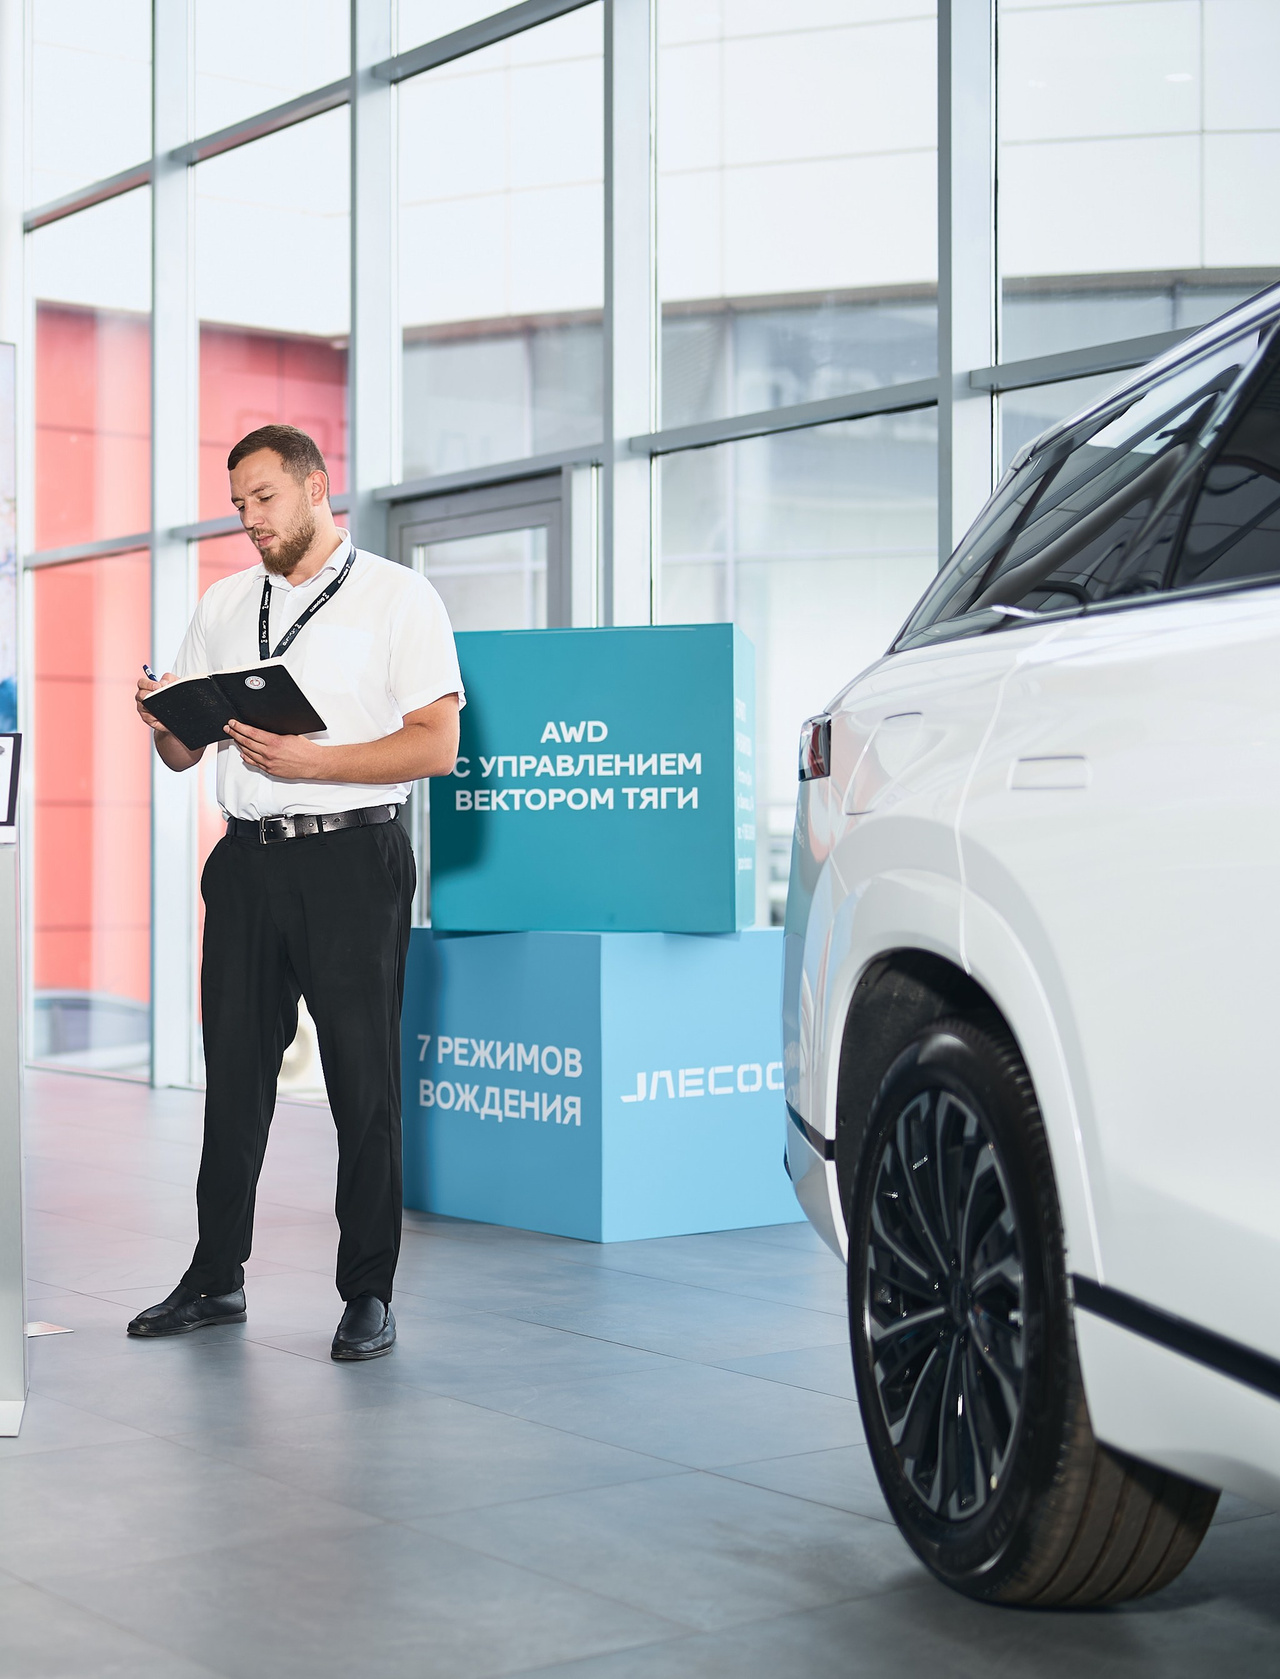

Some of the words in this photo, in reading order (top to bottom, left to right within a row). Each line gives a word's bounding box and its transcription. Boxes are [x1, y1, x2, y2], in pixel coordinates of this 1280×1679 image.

[540, 720, 609, 744] AWD
[452, 756, 471, 778] С
[479, 752, 702, 778] УПРАВЛЕНИЕМ
[455, 787, 614, 811] ВЕКТОРОМ
[622, 786, 699, 810] ТЯГИ
[417, 1034, 431, 1062] 7
[437, 1036, 583, 1078] РЕЖИМОВ
[419, 1079, 582, 1127] ВОЖДЕНИЯ
